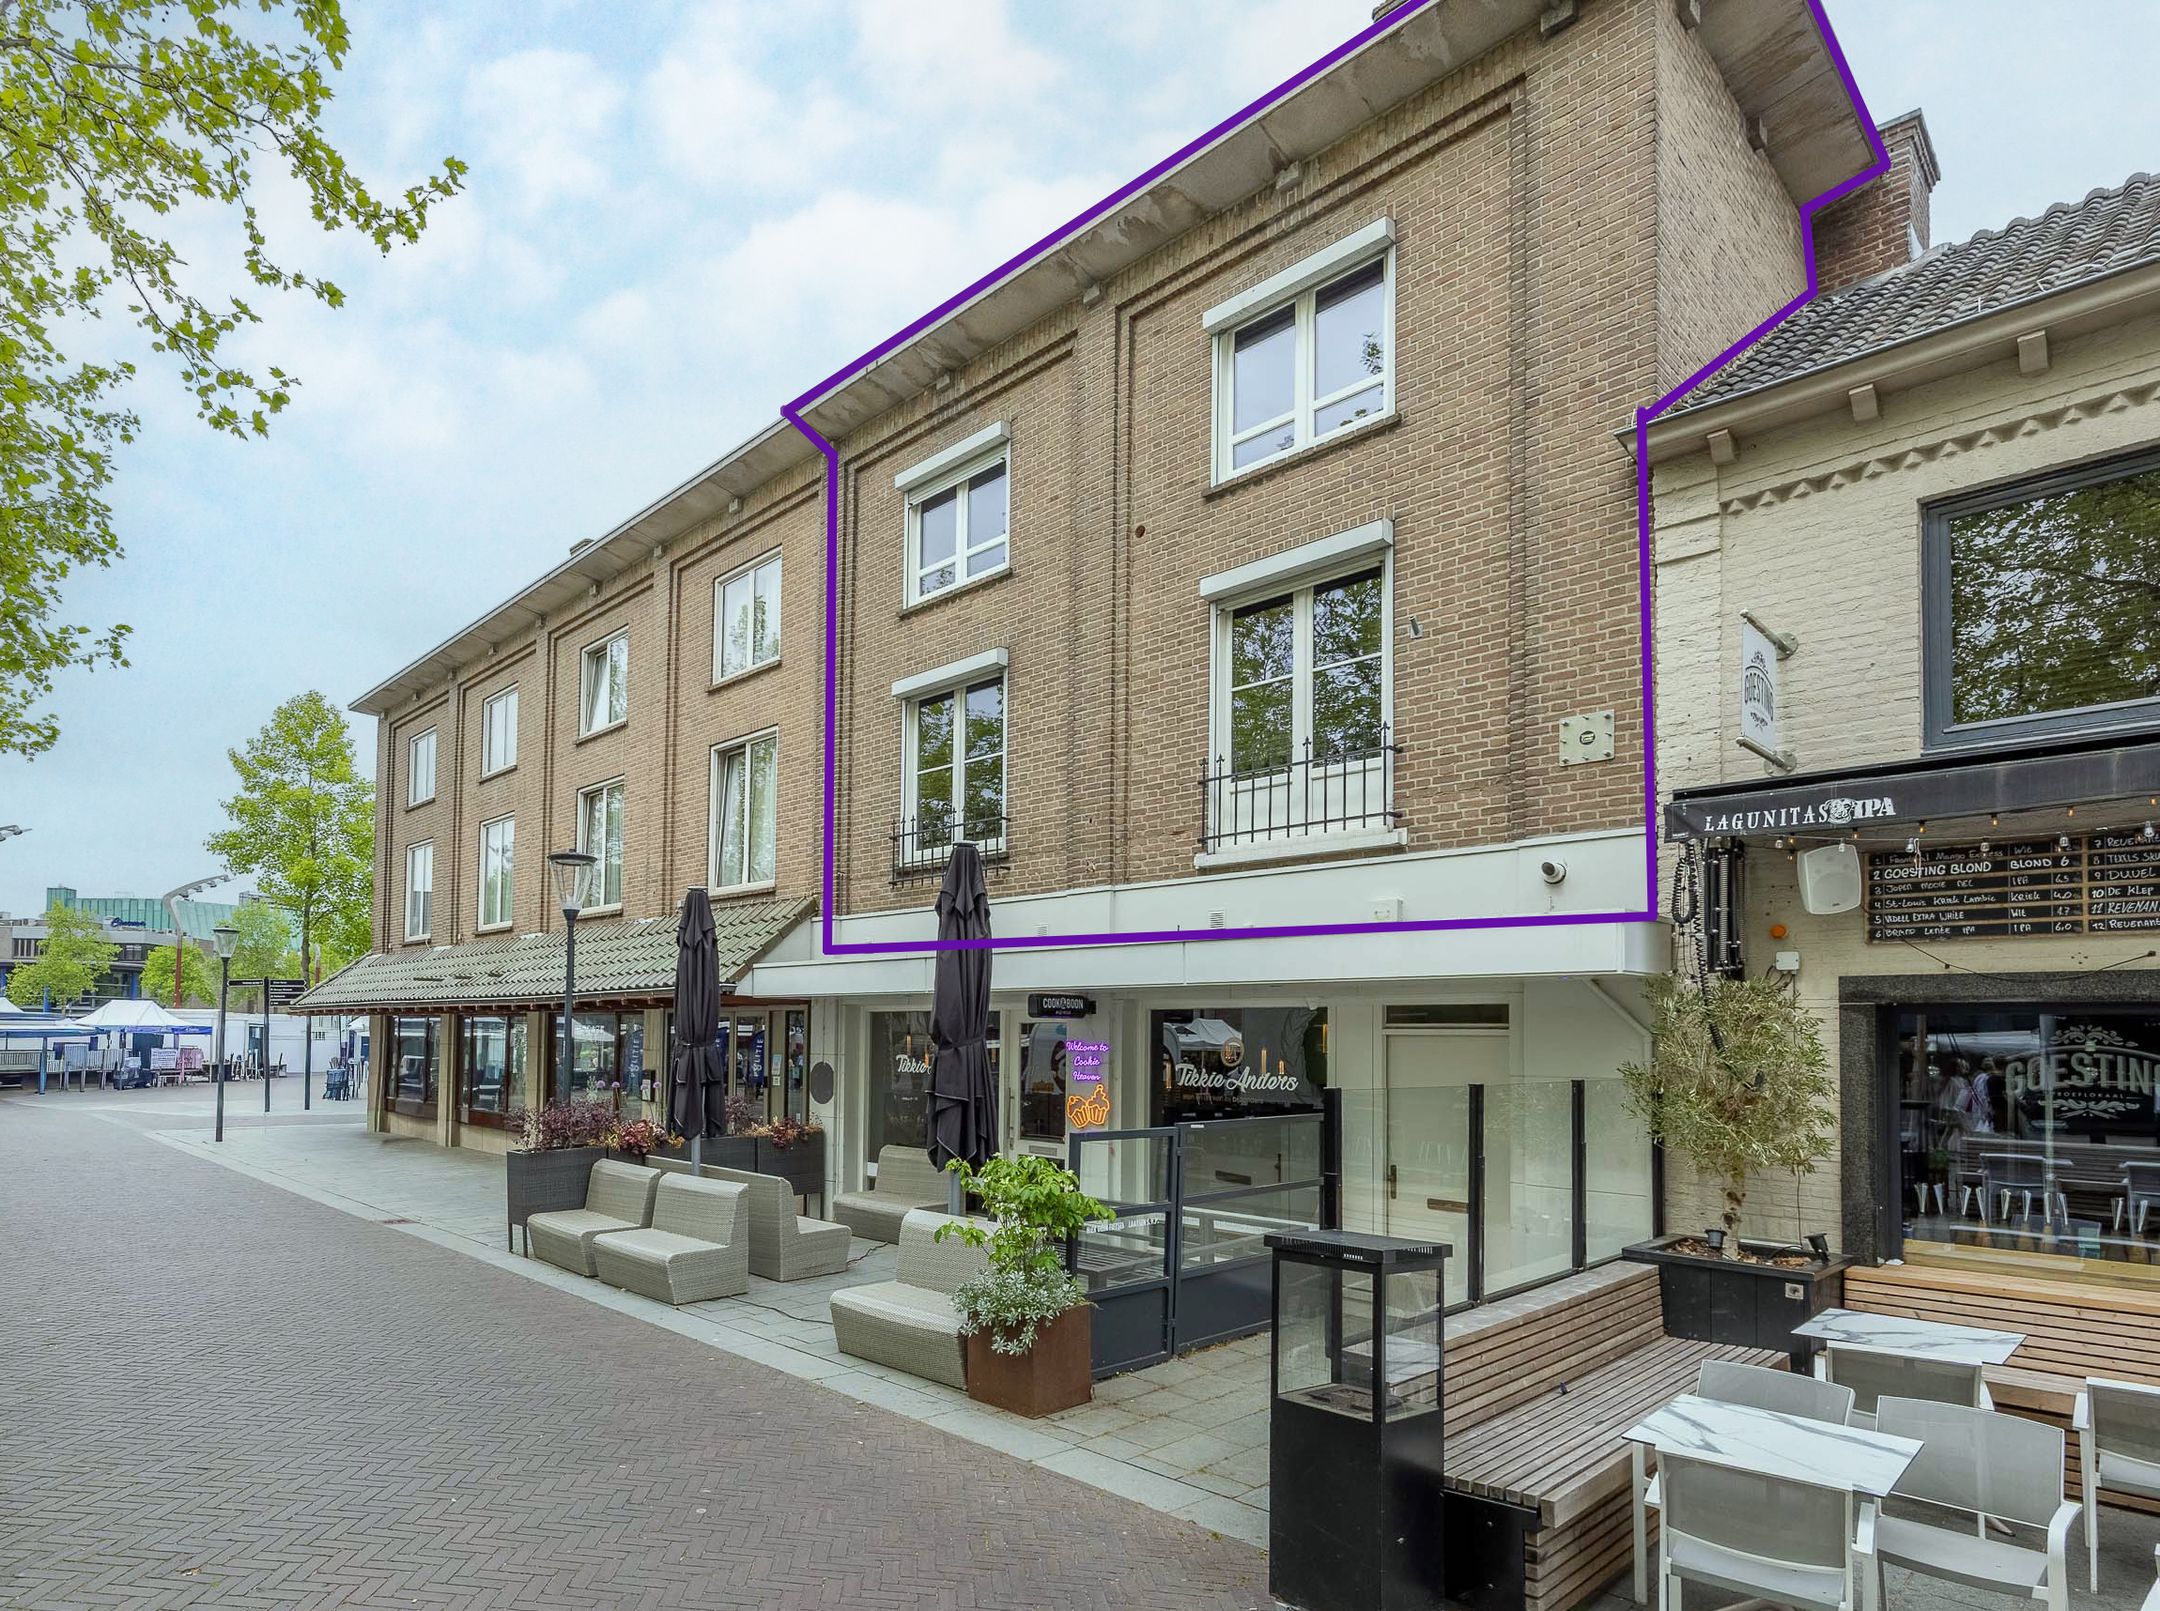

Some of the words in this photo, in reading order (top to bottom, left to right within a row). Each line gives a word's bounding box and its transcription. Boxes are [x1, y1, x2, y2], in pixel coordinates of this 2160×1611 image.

[1704, 804, 1828, 832] LAGUNITAS
[1852, 796, 1897, 820] IPA
[1873, 871, 1880, 880] 2
[1950, 861, 1992, 874] BLOND
[2010, 858, 2052, 869] BLOND
[2060, 855, 2070, 867] 6
[2092, 889, 2104, 898] 10
[2108, 900, 2160, 914] REVENAN
[1874, 915, 1882, 924] 5
[1912, 912, 1936, 922] EXTRA
[2092, 922, 2105, 930] 12
[1066, 1041, 1098, 1052] Welcome
[1099, 1042, 1109, 1052] to
[896, 1054, 927, 1074] Tikkie
[1073, 1056, 1100, 1066] Cookie
[1072, 1070, 1101, 1081] Heaven
[1175, 1063, 1226, 1088] Tikkie
[1226, 1066, 1299, 1093] Anders
